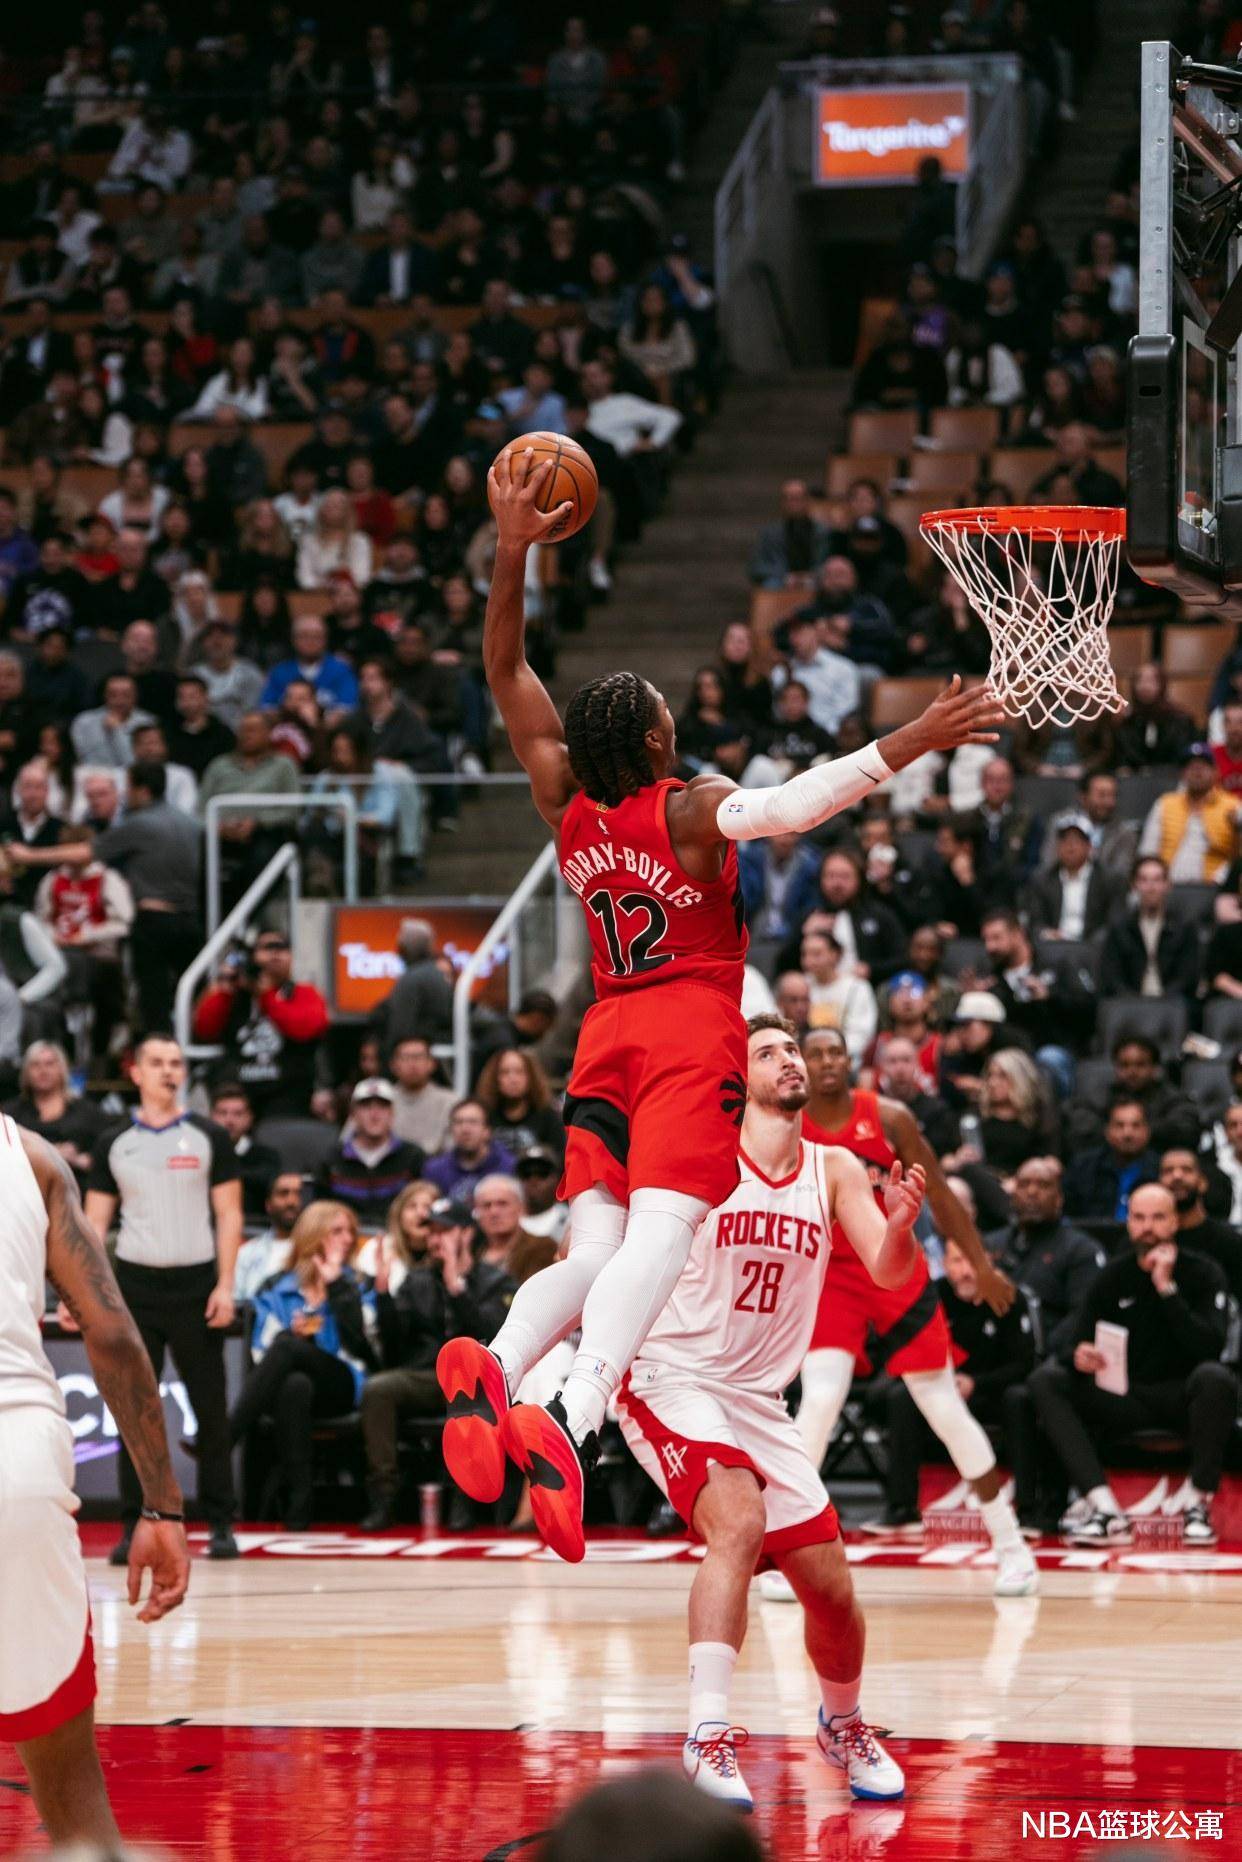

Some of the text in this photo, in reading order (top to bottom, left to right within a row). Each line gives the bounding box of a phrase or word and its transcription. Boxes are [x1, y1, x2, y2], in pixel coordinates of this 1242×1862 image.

[562, 842, 703, 908] URRAY-BOYLES
[586, 889, 675, 975] 12
[716, 1210, 821, 1260] ROCKETS
[734, 1260, 784, 1314] 28
